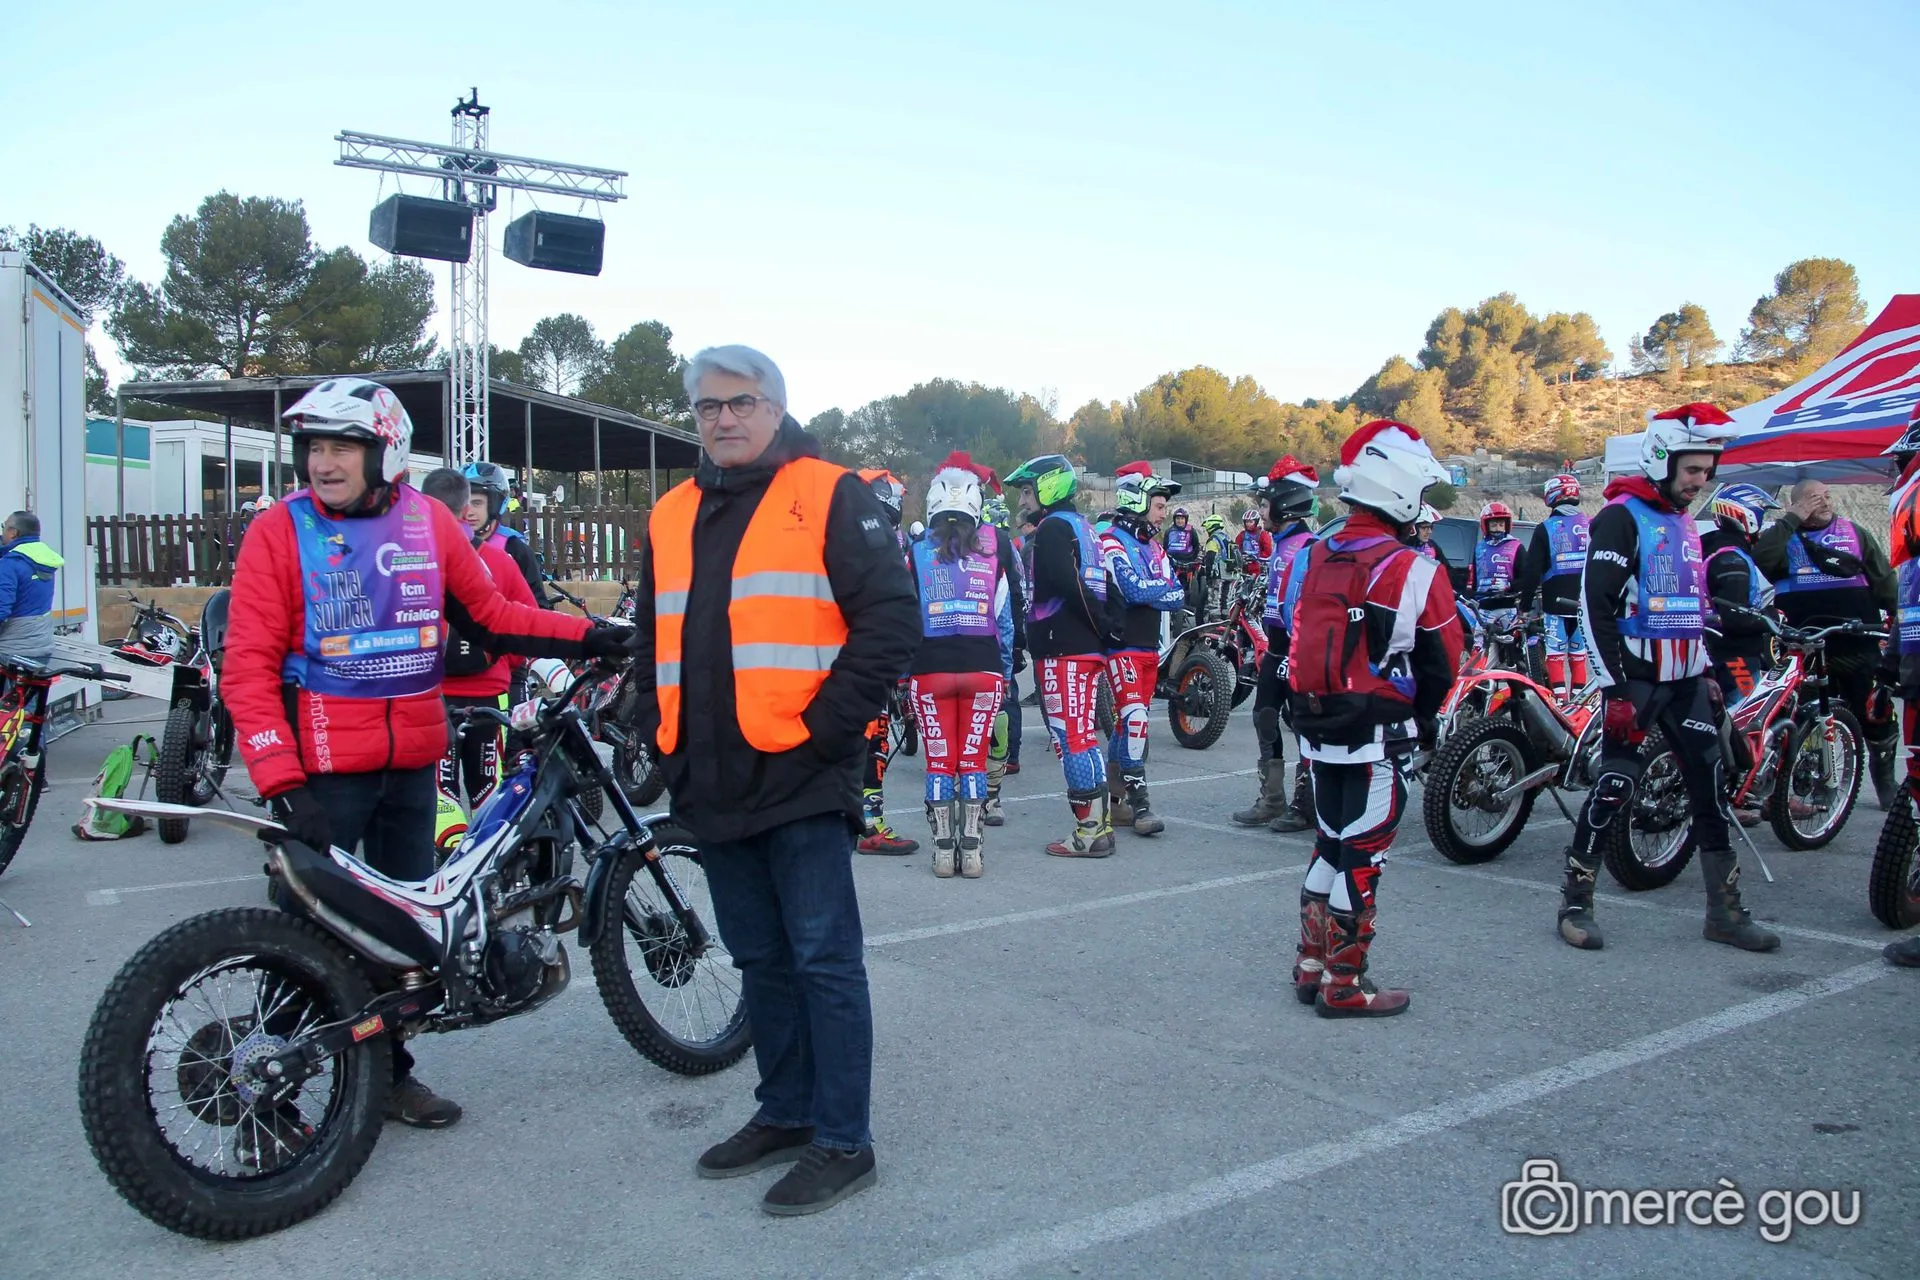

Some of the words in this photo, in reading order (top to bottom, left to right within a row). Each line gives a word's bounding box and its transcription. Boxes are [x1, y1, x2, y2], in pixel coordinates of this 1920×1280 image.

[1592, 550, 1629, 568] MOTUL
[400, 583, 425, 596] fcm
[395, 609, 440, 623] TrialGo
[325, 643, 350, 652] Per
[354, 638, 371, 649] La
[373, 634, 417, 648] Marató
[1067, 661, 1078, 717] COMAS
[920, 692, 942, 738] SPEA
[987, 680, 1002, 738] COMAS
[963, 711, 987, 755] SPEA
[439, 750, 452, 782] TR
[485, 739, 497, 777] TRS
